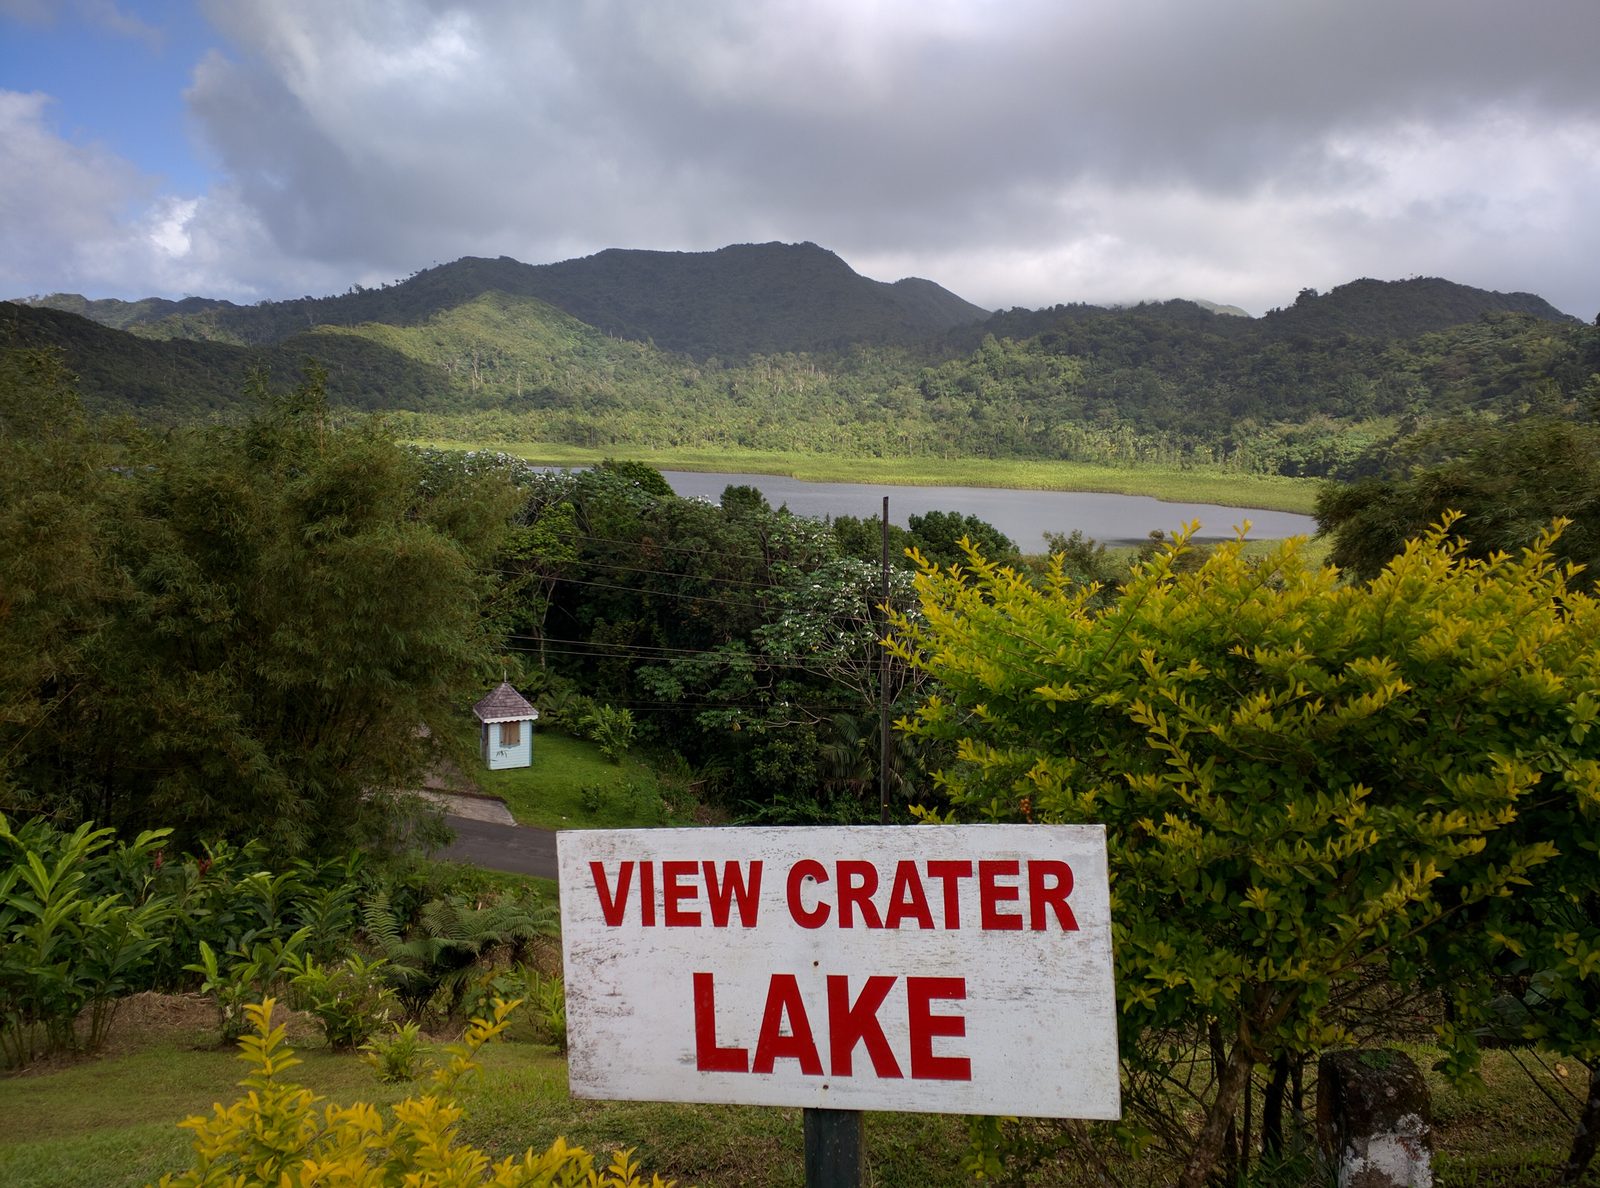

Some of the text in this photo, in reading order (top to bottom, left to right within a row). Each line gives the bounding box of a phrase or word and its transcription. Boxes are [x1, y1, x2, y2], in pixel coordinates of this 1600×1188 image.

[589, 859, 1080, 931] VIEW CRATER
[692, 972, 972, 1081] LAKE
